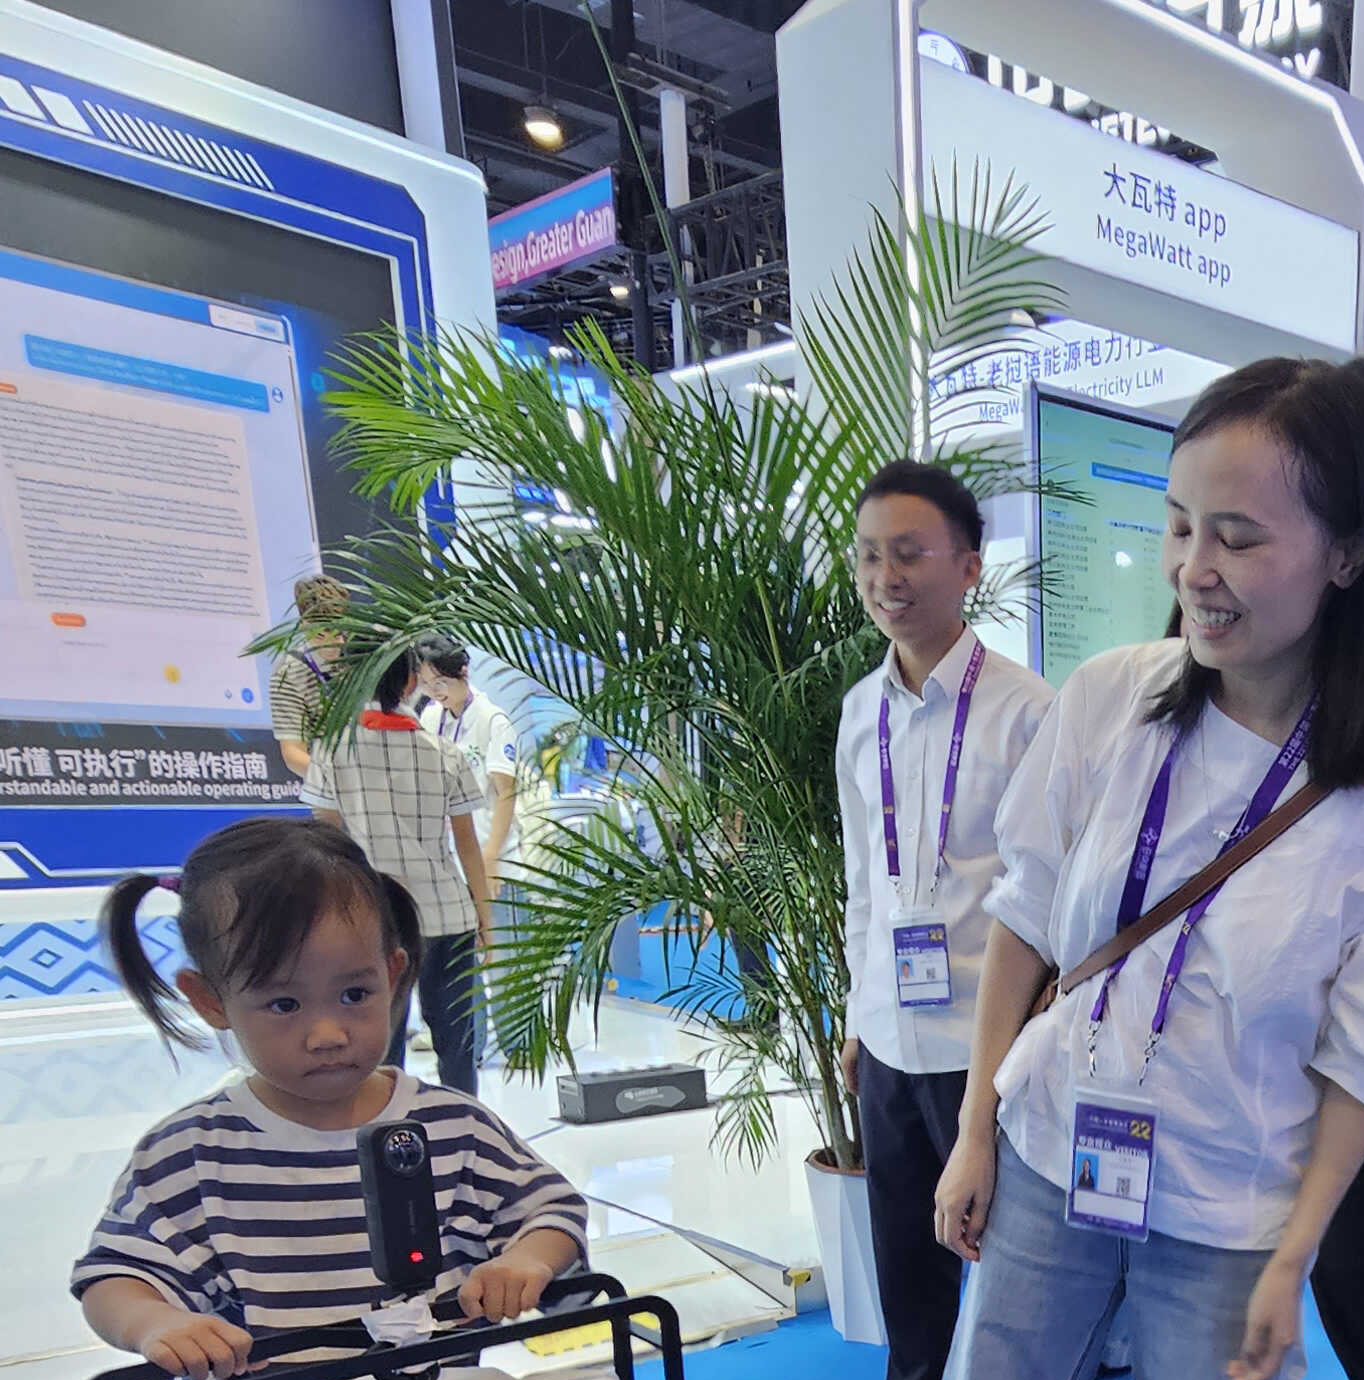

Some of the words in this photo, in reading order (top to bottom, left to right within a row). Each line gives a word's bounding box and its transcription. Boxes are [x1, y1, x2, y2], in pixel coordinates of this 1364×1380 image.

[1103, 163, 1177, 222] 大瓦特
[1185, 202, 1227, 243] app
[1096, 213, 1193, 271] MegaWatt
[1198, 255, 1232, 288] app
[1066, 376, 1132, 398] lectricity
[1136, 367, 1164, 389] LLM
[90, 780, 119, 796] and
[122, 780, 201, 797] actionable
[204, 783, 271, 799] operating
[1129, 1119, 1152, 1140] 22
